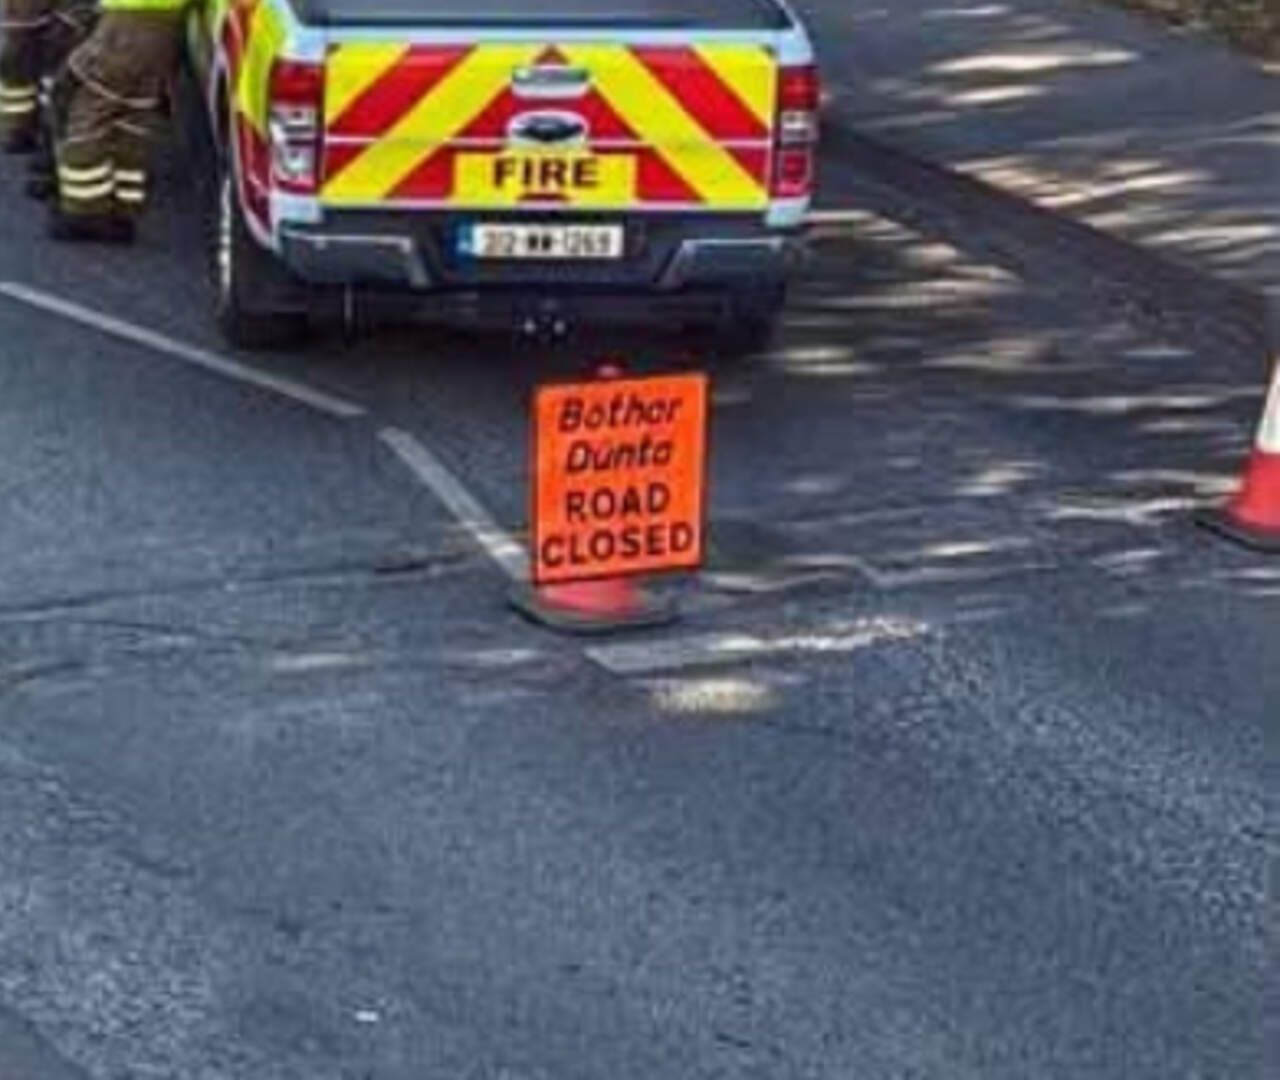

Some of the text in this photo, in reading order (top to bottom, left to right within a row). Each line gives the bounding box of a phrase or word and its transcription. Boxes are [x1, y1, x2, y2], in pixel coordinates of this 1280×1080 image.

[494, 158, 599, 188] FIRE
[566, 482, 671, 524] ROAD
[541, 522, 694, 568] CLOSED
